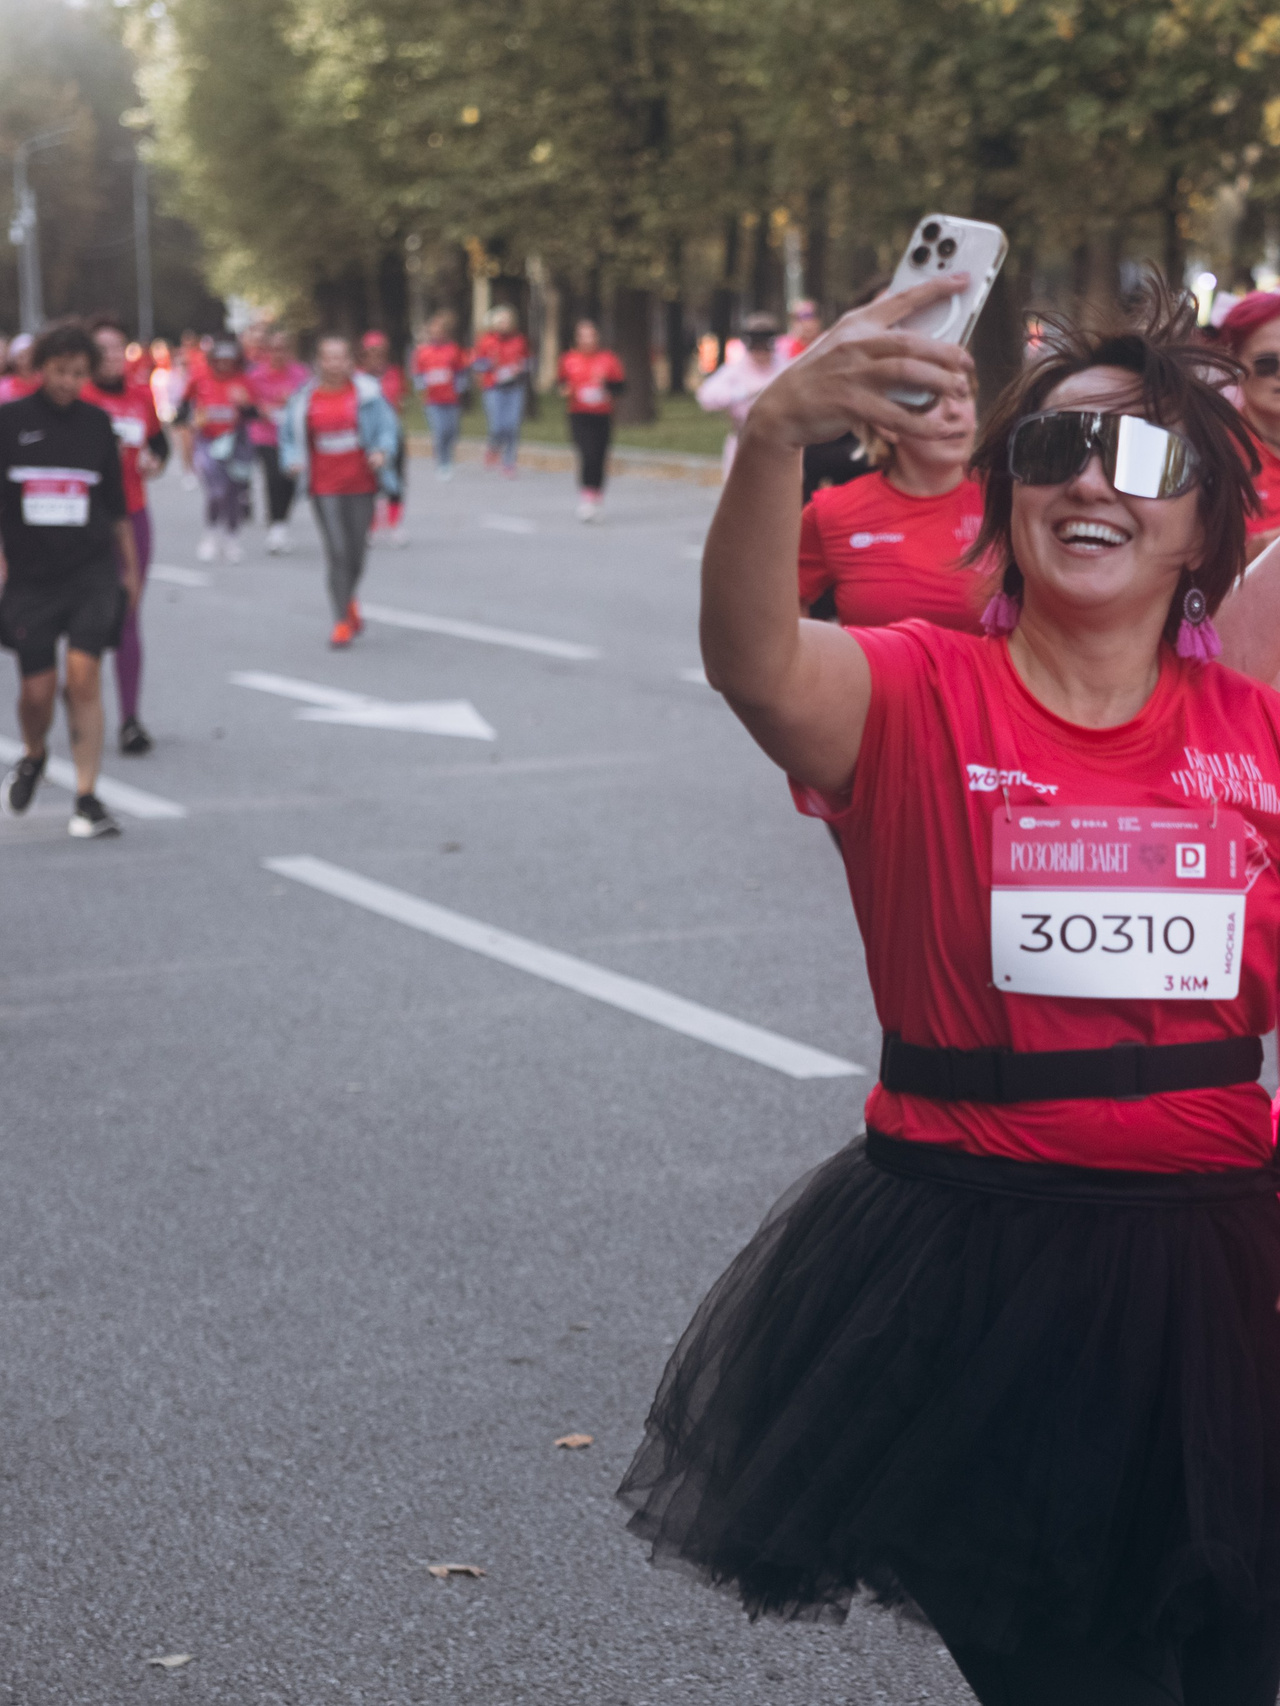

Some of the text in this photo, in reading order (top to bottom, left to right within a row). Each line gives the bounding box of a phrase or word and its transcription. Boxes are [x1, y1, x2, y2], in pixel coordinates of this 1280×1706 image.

[1010, 838, 1131, 873] РОЗОВЫЙ ЗАБЕГ
[1181, 847, 1200, 868] D
[1019, 913, 1196, 955] 30310
[1225, 912, 1236, 975] МОСКВА
[1163, 975, 1174, 991] 3
